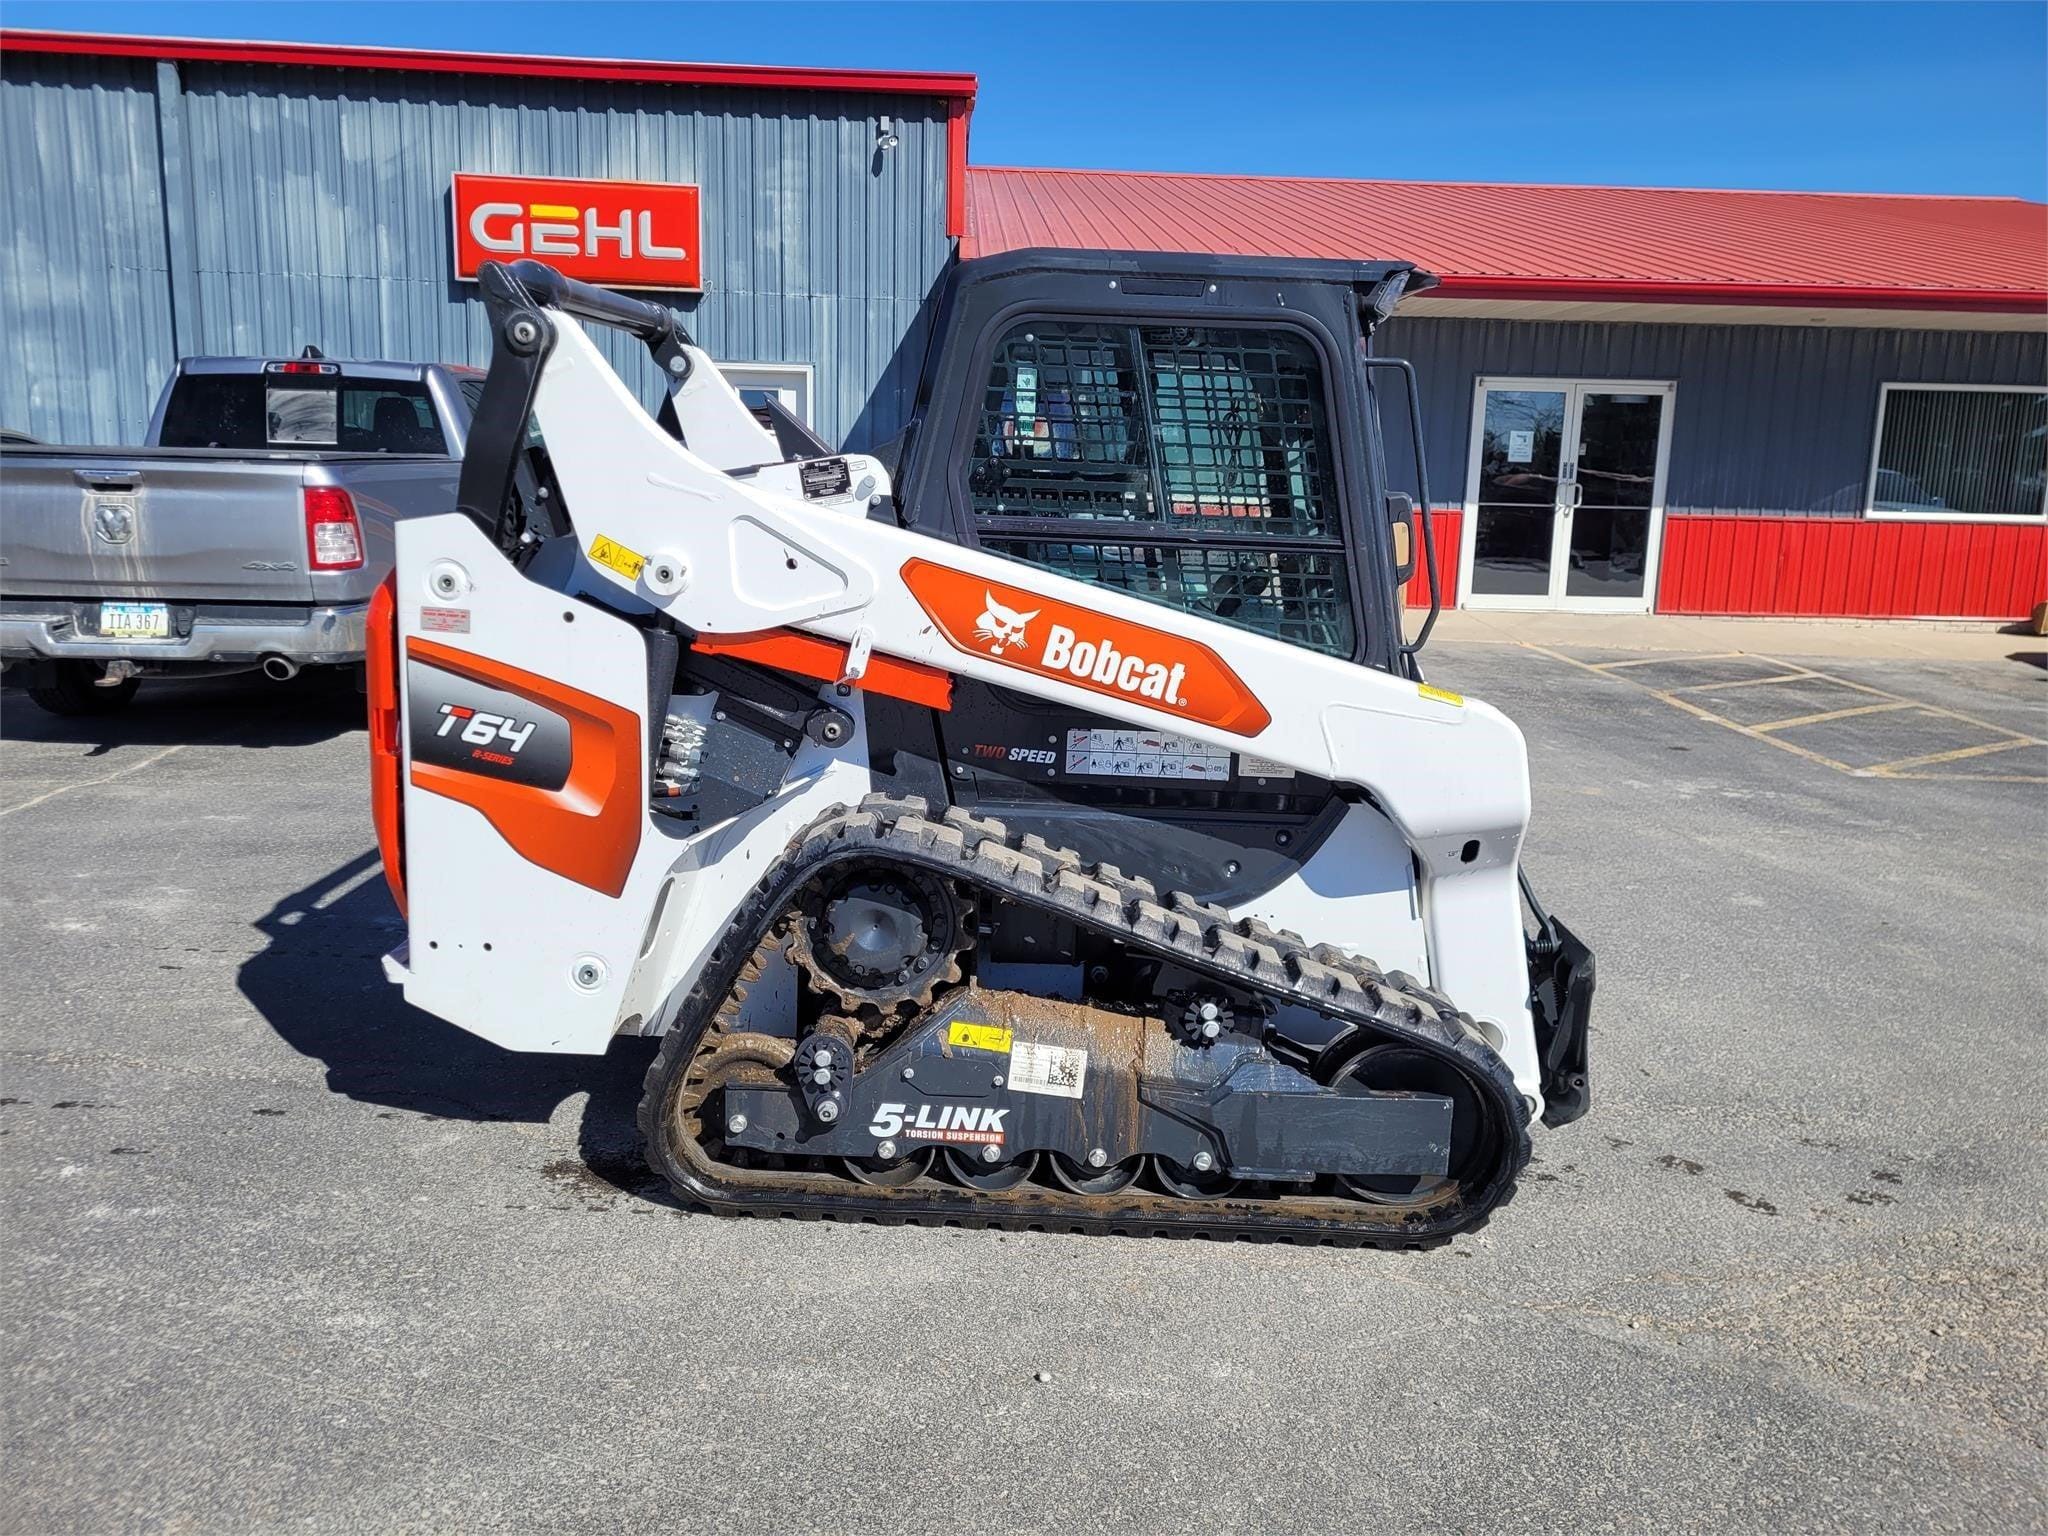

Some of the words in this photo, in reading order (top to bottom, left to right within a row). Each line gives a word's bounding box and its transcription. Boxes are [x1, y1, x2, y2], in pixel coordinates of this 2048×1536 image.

[469, 202, 686, 260] GEHL
[109, 613, 132, 629] IIA
[136, 614, 159, 630] 367
[435, 703, 538, 753] T64
[471, 749, 515, 766] R-SERIES
[974, 744, 1006, 759] TWO
[1008, 747, 1056, 764] SPEED
[868, 1103, 1010, 1138] 5-LINK
[905, 1129, 944, 1140] TORSION
[946, 1131, 1002, 1144] SUSPENSION
